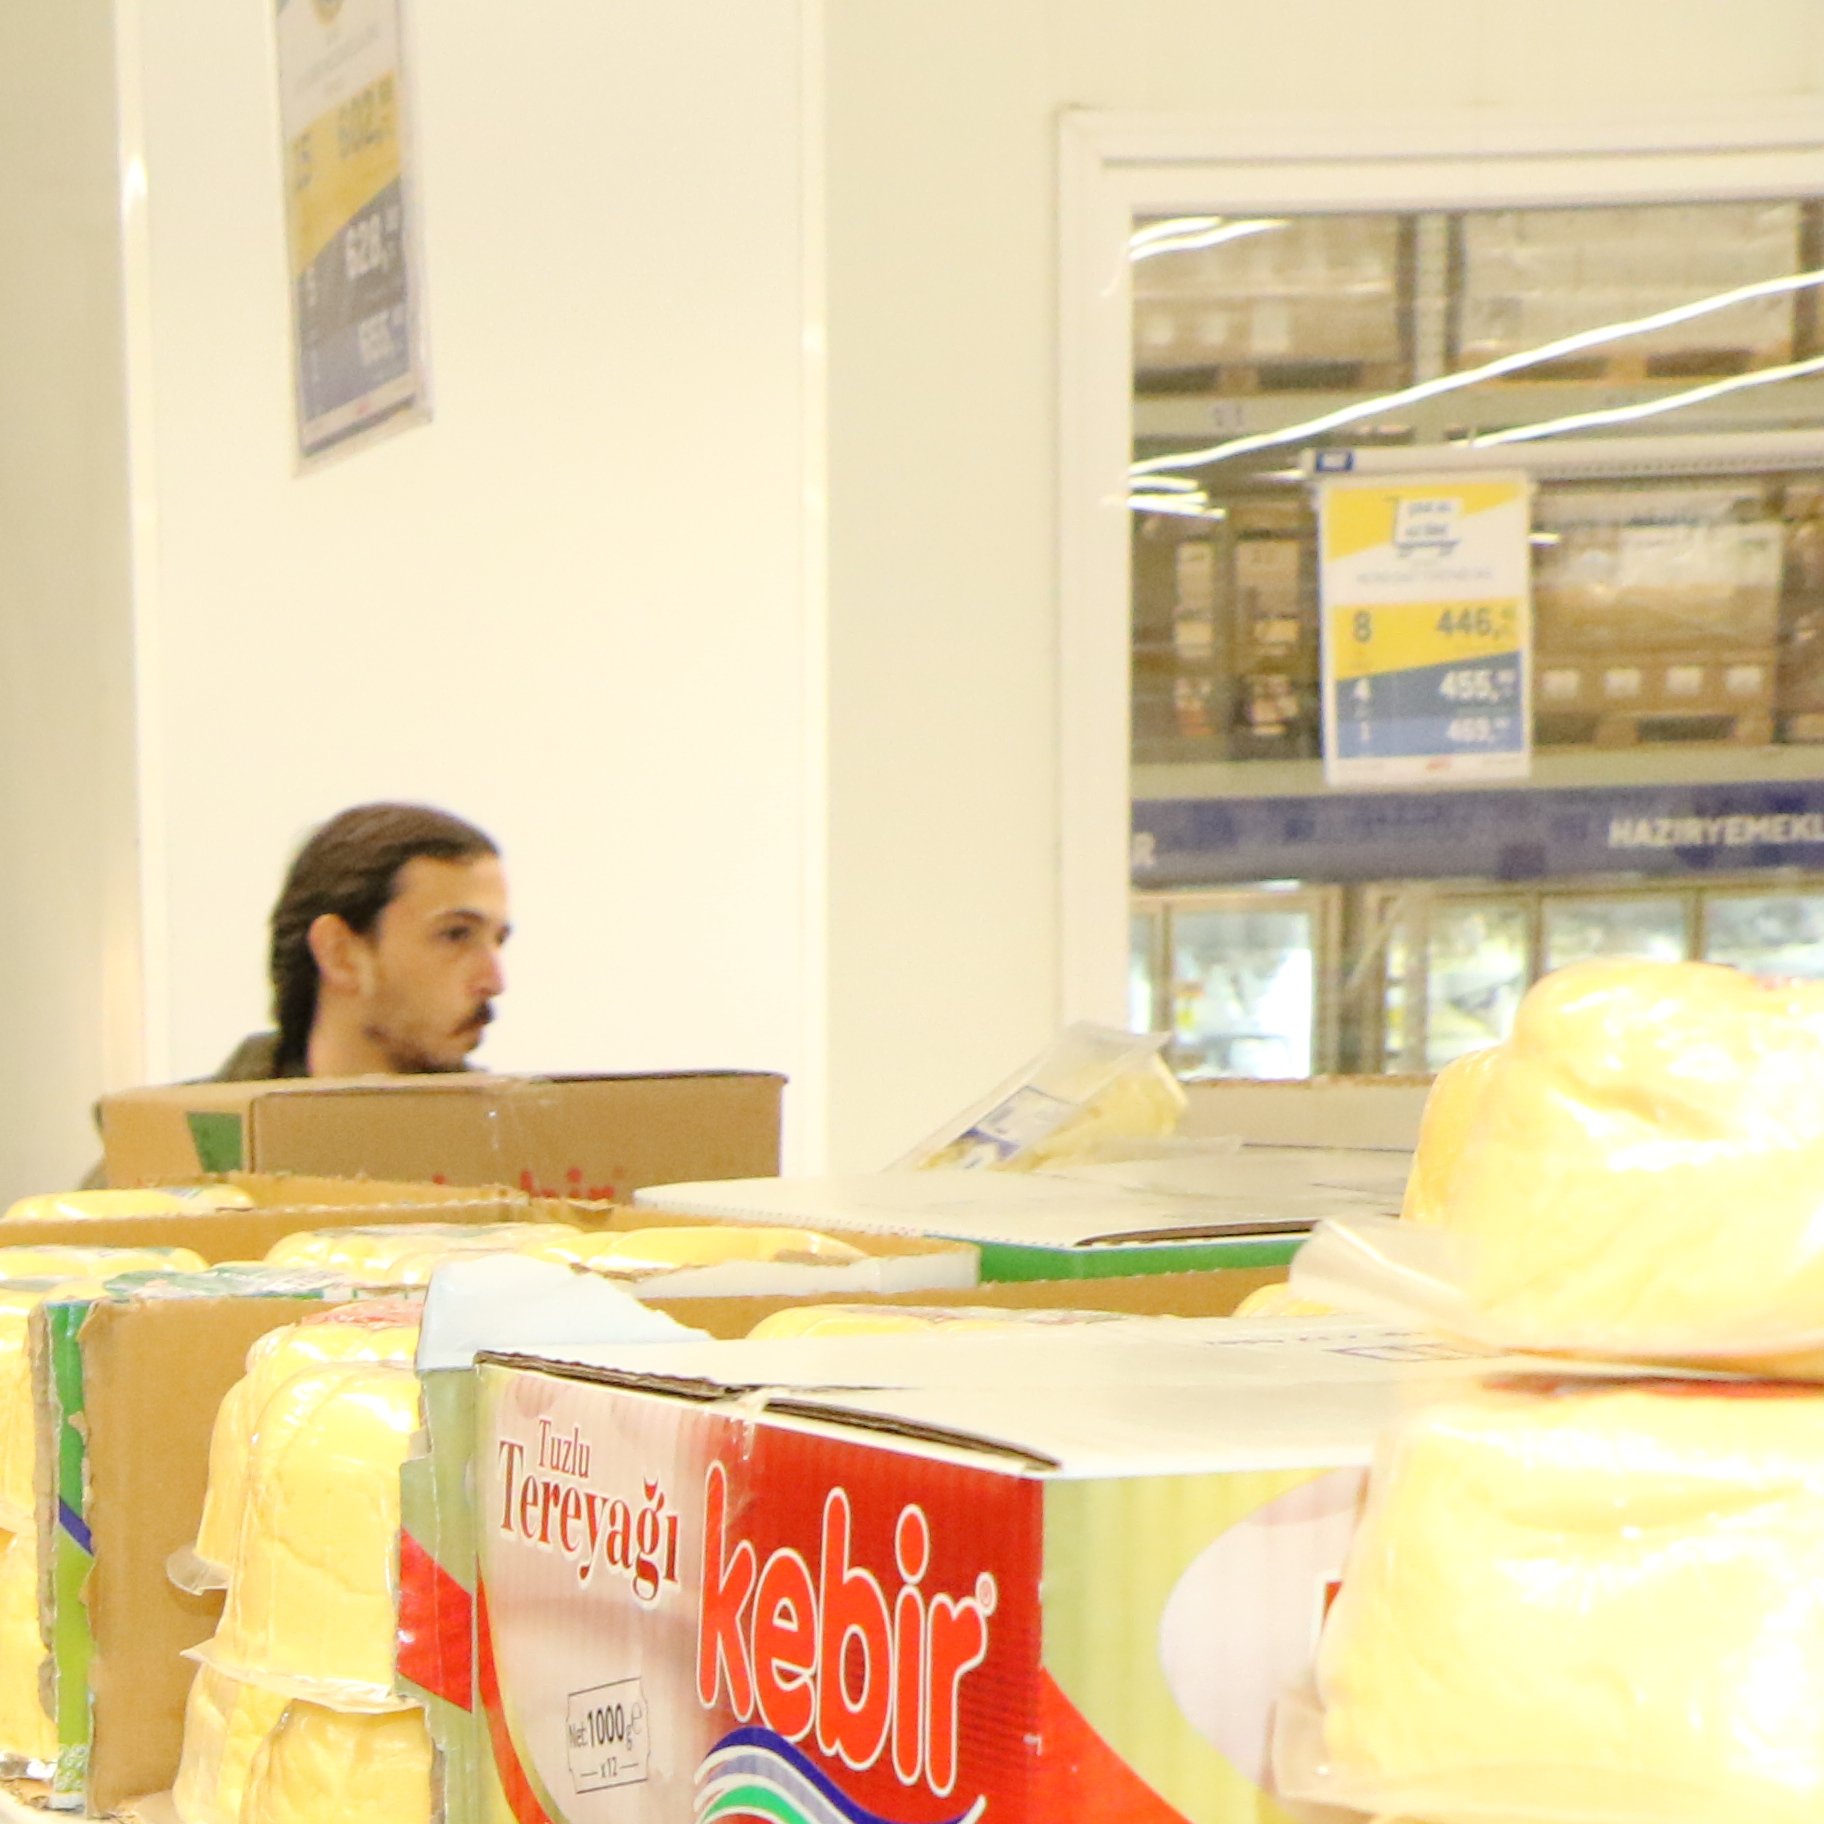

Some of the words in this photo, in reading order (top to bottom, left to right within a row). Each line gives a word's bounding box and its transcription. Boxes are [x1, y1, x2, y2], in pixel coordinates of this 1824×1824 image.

[498, 1439, 680, 1601] Tereyağı
[538, 1419, 591, 1479] Tuzlu
[695, 1459, 990, 1798] kebir
